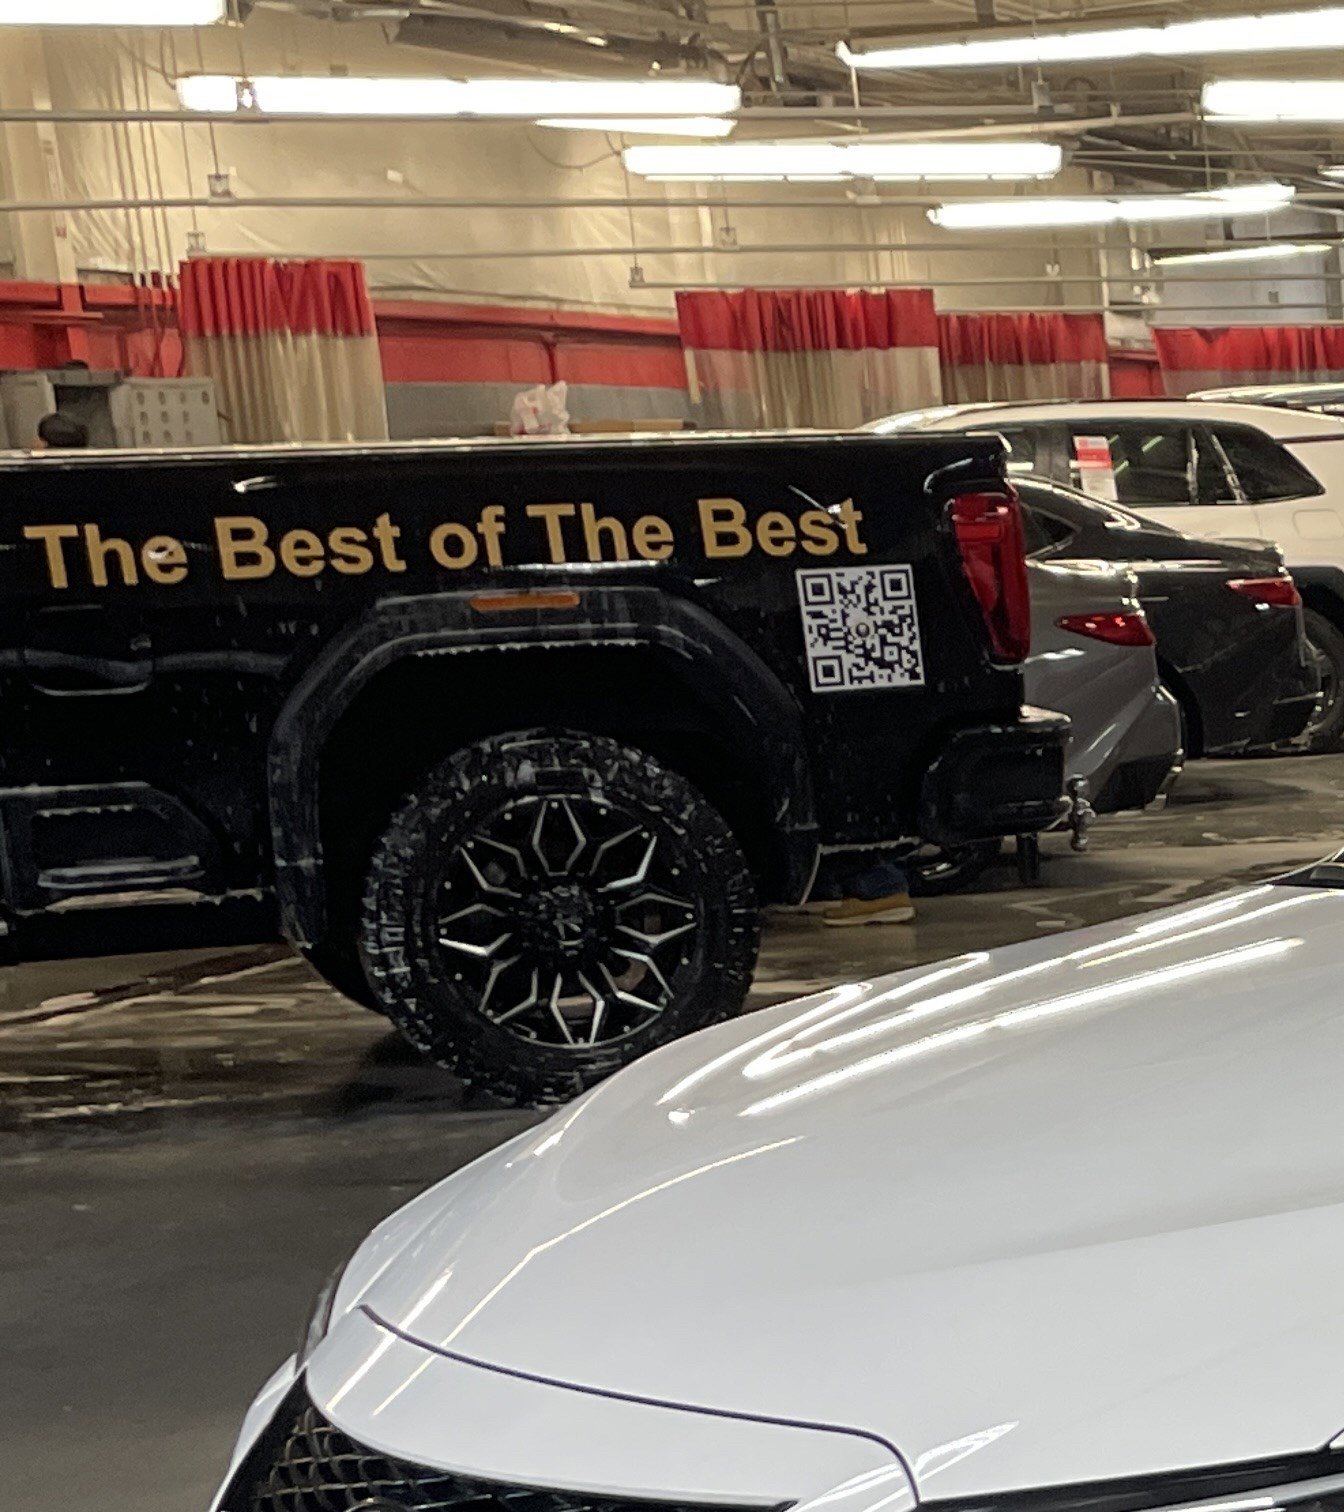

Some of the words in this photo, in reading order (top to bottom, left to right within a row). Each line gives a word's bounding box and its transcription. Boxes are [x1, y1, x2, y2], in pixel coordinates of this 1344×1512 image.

[24, 524, 187, 588] The
[215, 514, 406, 579] Best
[431, 506, 505, 568] of
[526, 503, 673, 563] The
[698, 499, 866, 557] Best
